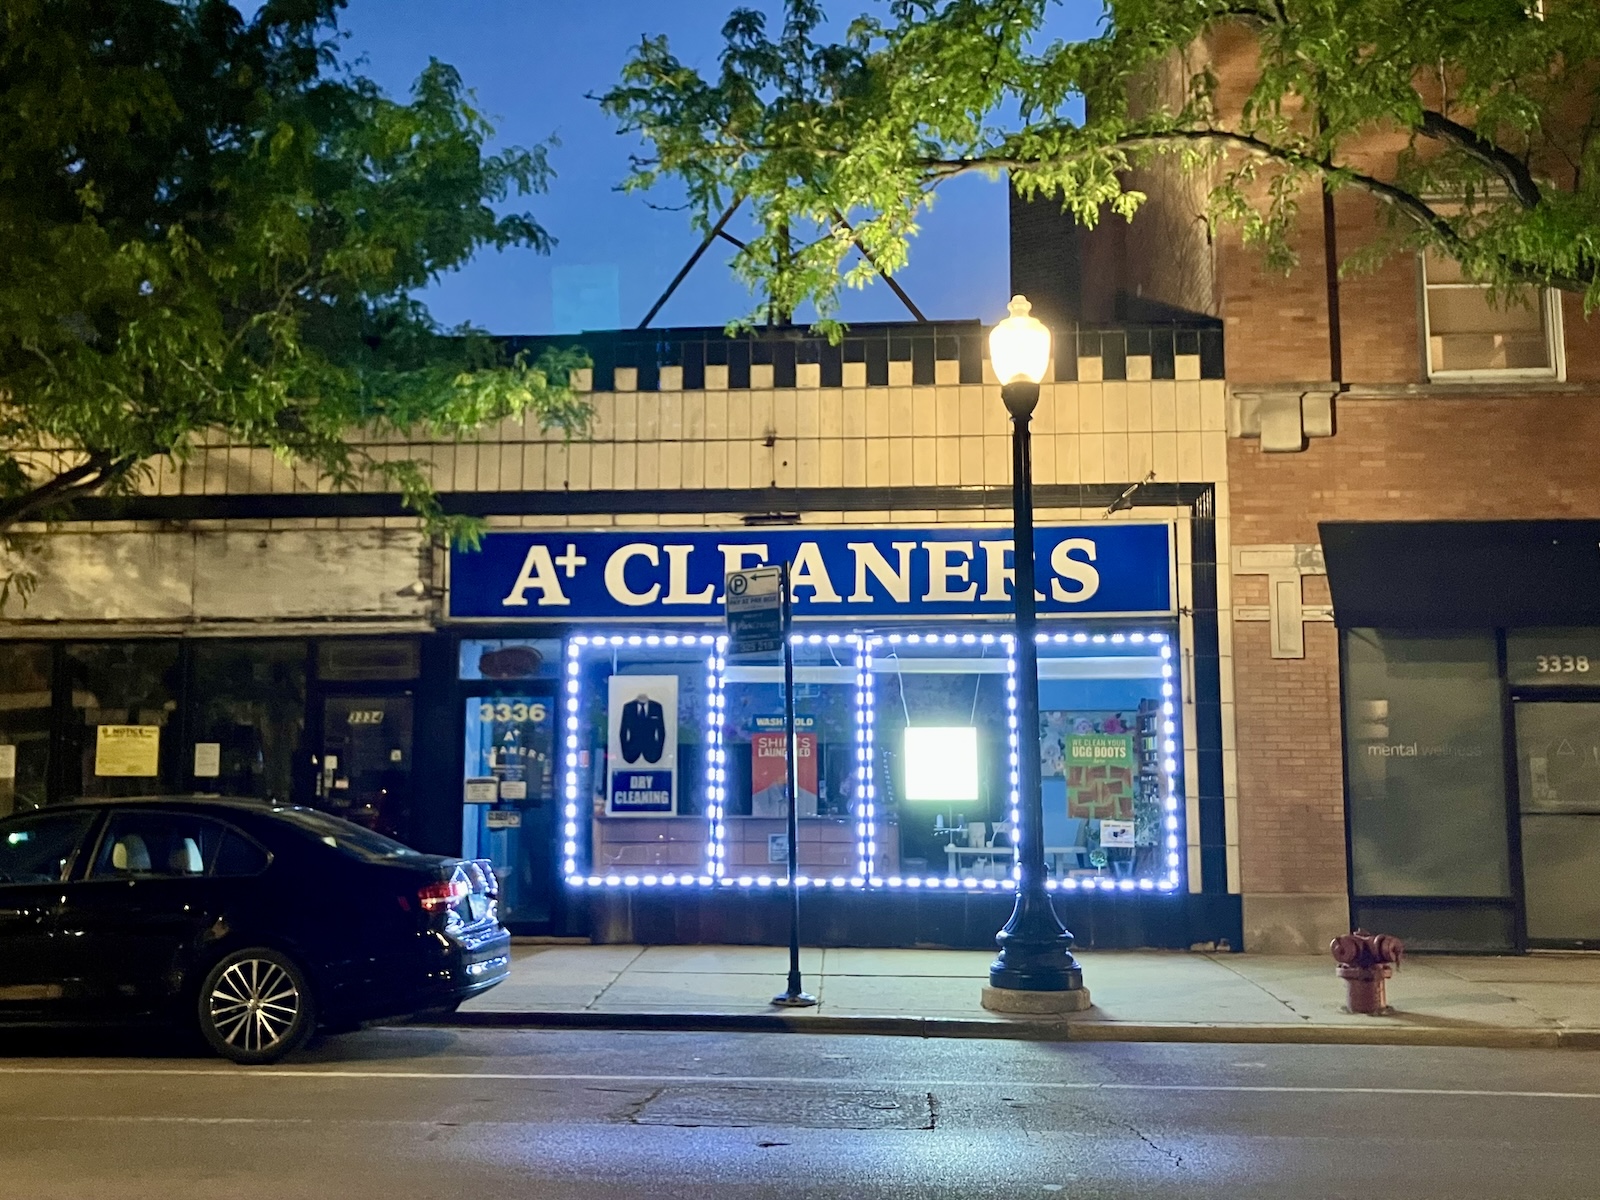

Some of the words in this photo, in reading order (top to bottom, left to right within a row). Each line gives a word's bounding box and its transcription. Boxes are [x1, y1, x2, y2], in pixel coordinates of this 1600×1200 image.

[502, 543, 587, 606] A+
[1536, 655, 1589, 673] 3338
[480, 703, 546, 722] 3336
[756, 718, 782, 726] WASH
[788, 718, 814, 727] OLD
[758, 737, 811, 748] SHIS
[1083, 739, 1106, 747] CLEAN
[758, 748, 811, 757] LAUNED
[1072, 747, 1092, 757] UGG
[1094, 747, 1127, 758] BOOTS
[1368, 742, 1418, 757] mental
[630, 776, 653, 789] DRY
[614, 790, 669, 805] CLEANING
